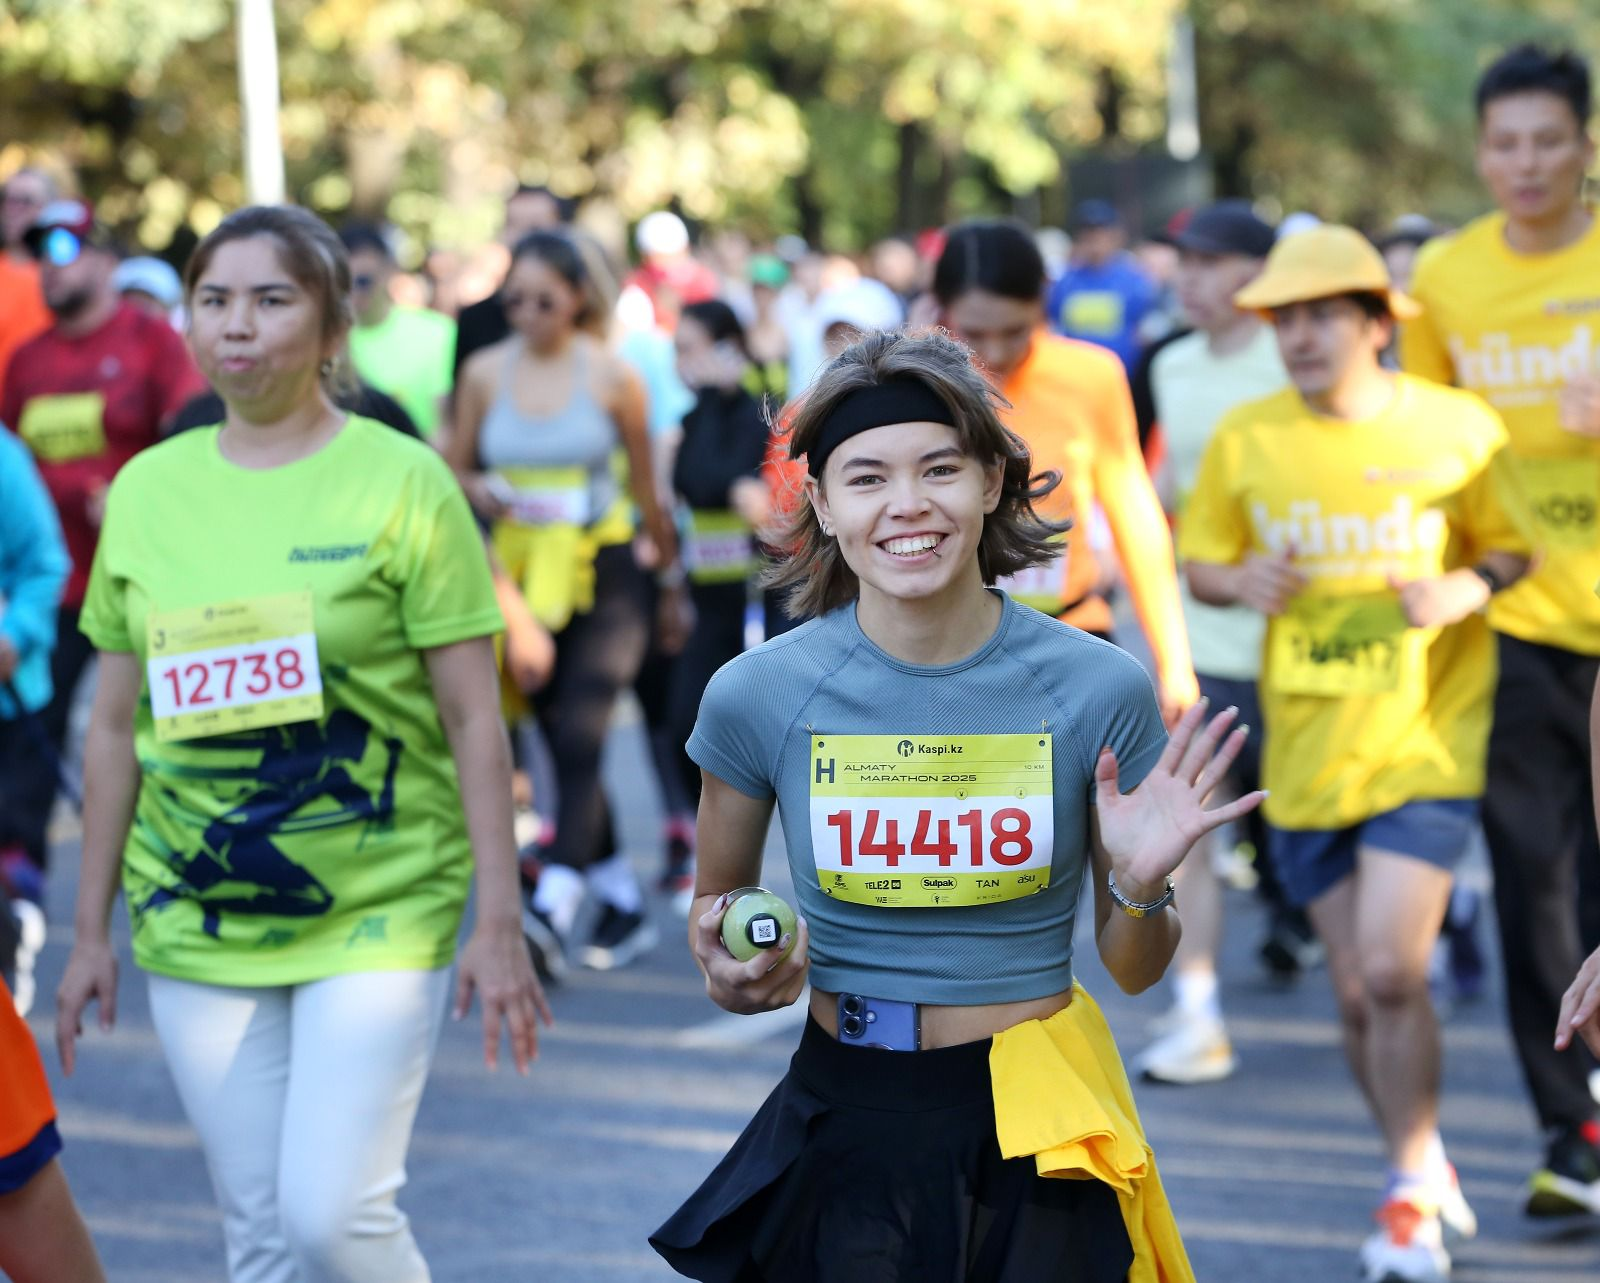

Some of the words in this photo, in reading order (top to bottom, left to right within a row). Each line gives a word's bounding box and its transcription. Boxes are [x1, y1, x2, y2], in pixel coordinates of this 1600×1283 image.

[163, 648, 305, 707] 12738
[918, 744, 963, 757] Kaspi.kz
[815, 758, 835, 784] H
[860, 774, 939, 782] MARATHON
[941, 774, 977, 782] 2025
[827, 807, 1033, 867] 14418
[864, 880, 890, 890] TELE2
[923, 879, 954, 889] Sulpak
[975, 879, 1000, 889] TAN
